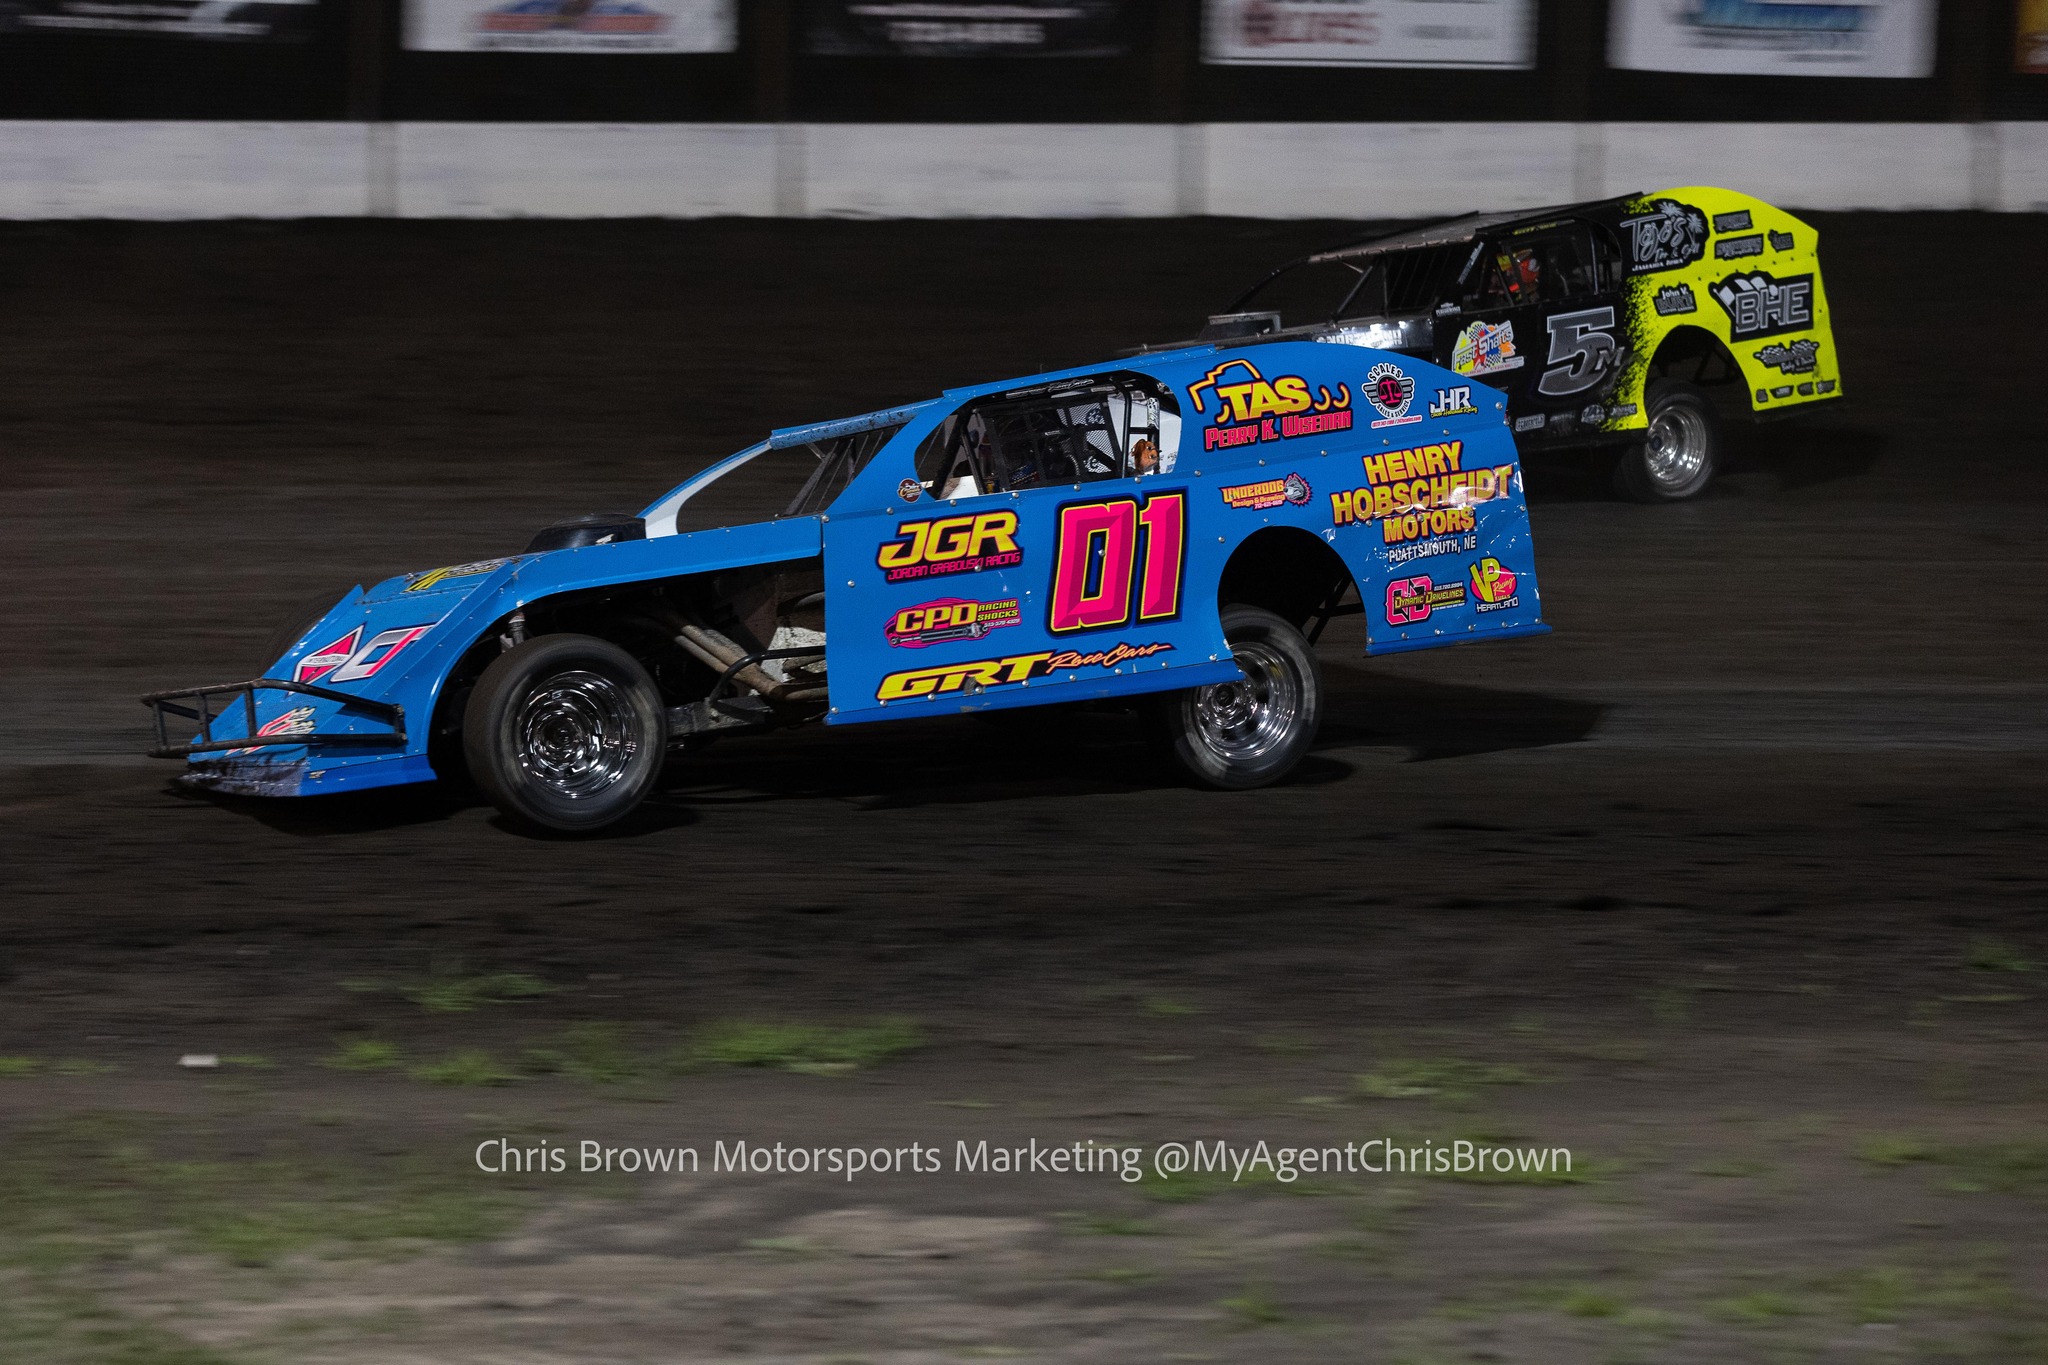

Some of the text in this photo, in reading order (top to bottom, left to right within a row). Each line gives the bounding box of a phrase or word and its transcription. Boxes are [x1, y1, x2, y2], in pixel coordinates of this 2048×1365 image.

[1735, 282, 1809, 334] BHE
[1479, 320, 1513, 355] Shafts
[1369, 363, 1402, 381] SCALES
[1216, 377, 1312, 421] TAS
[1430, 386, 1471, 413] JHR
[1205, 425, 1258, 450] PERRY
[1262, 418, 1278, 441] K.
[1282, 411, 1351, 437] WISEMAN
[1362, 441, 1463, 484] HENRY
[1221, 480, 1284, 502] UNDERDOG
[1331, 464, 1513, 524] HOBSCHEIDT
[876, 511, 1019, 568] JGR
[1383, 506, 1475, 544] MOTORS
[1464, 536, 1477, 550] NE
[888, 565, 928, 580] JORDAN
[985, 552, 1020, 566] RACING
[1051, 494, 1183, 632] 01
[1470, 557, 1500, 603] VP
[1492, 576, 1515, 596] Racing
[896, 603, 978, 632] CPD
[977, 610, 1018, 621] SHOCKS
[978, 600, 1017, 611] RACING
[1476, 597, 1518, 612] HEARTLAND
[877, 644, 1171, 700] GRT Race Cars
